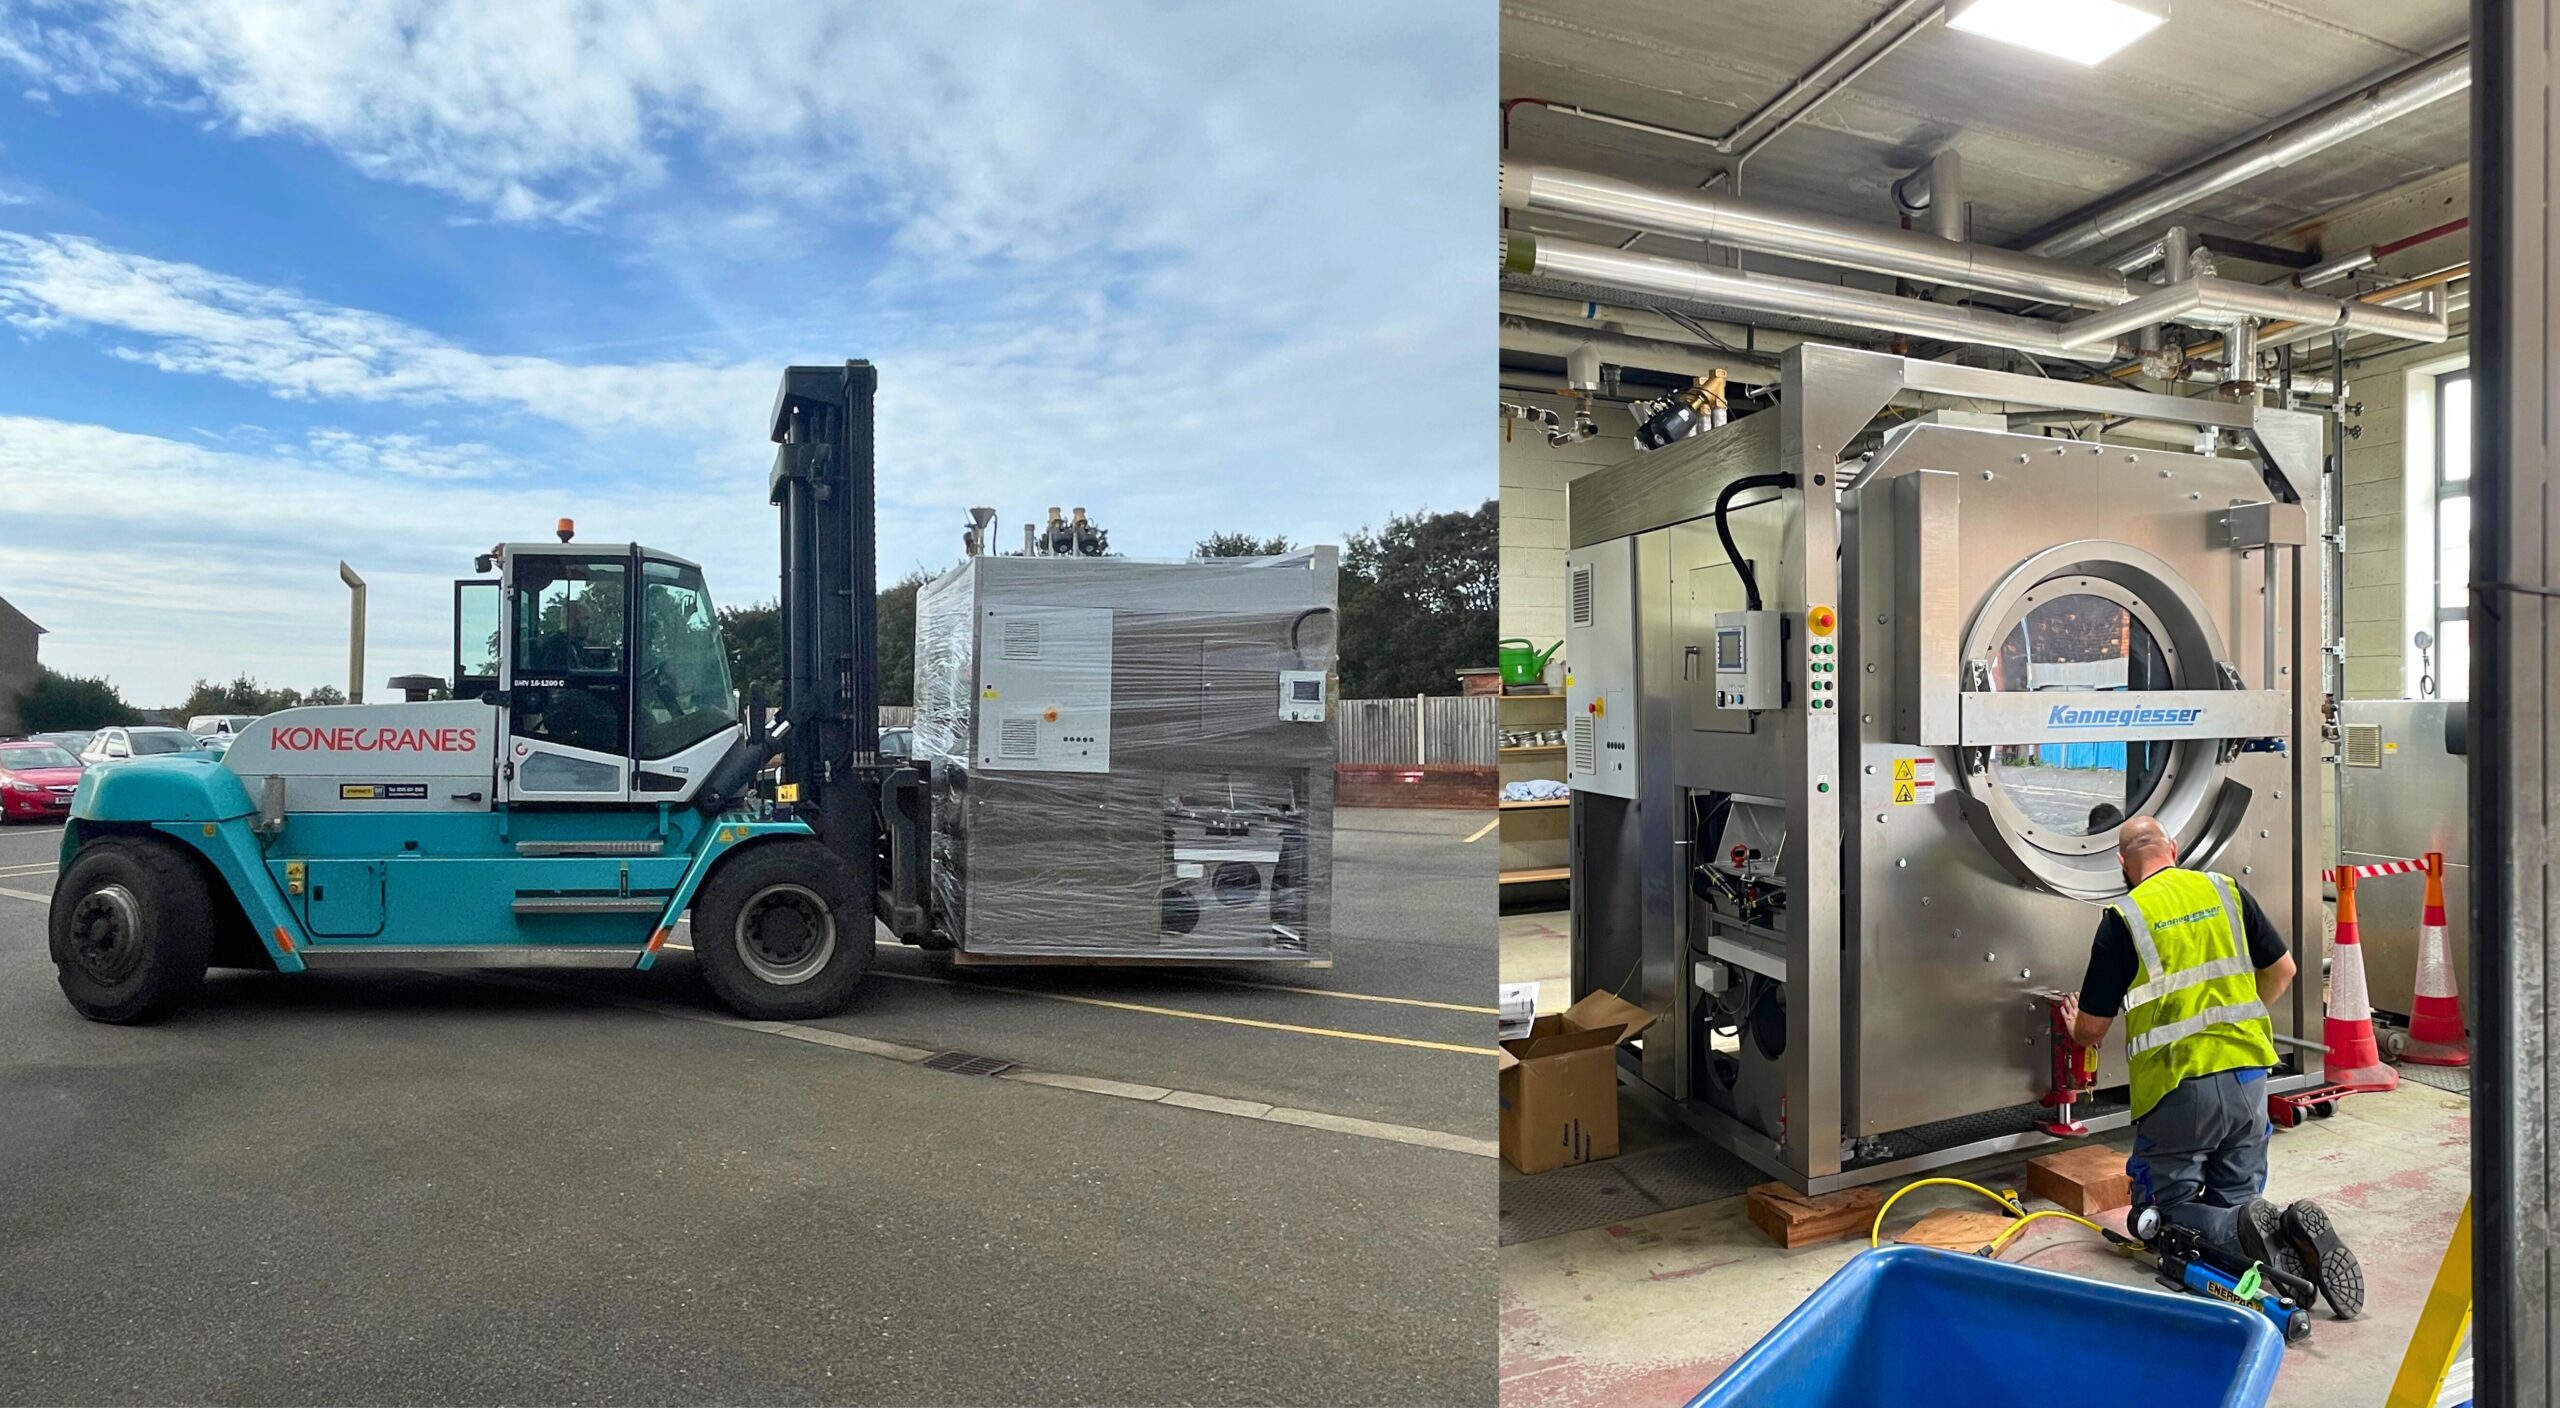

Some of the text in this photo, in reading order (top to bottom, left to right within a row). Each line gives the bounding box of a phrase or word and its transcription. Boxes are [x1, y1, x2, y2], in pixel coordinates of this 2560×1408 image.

[2048, 704, 2202, 727] Kannegiesser
[271, 727, 477, 752] KONECRANES
[2153, 905, 2221, 931] Kannegiesser
